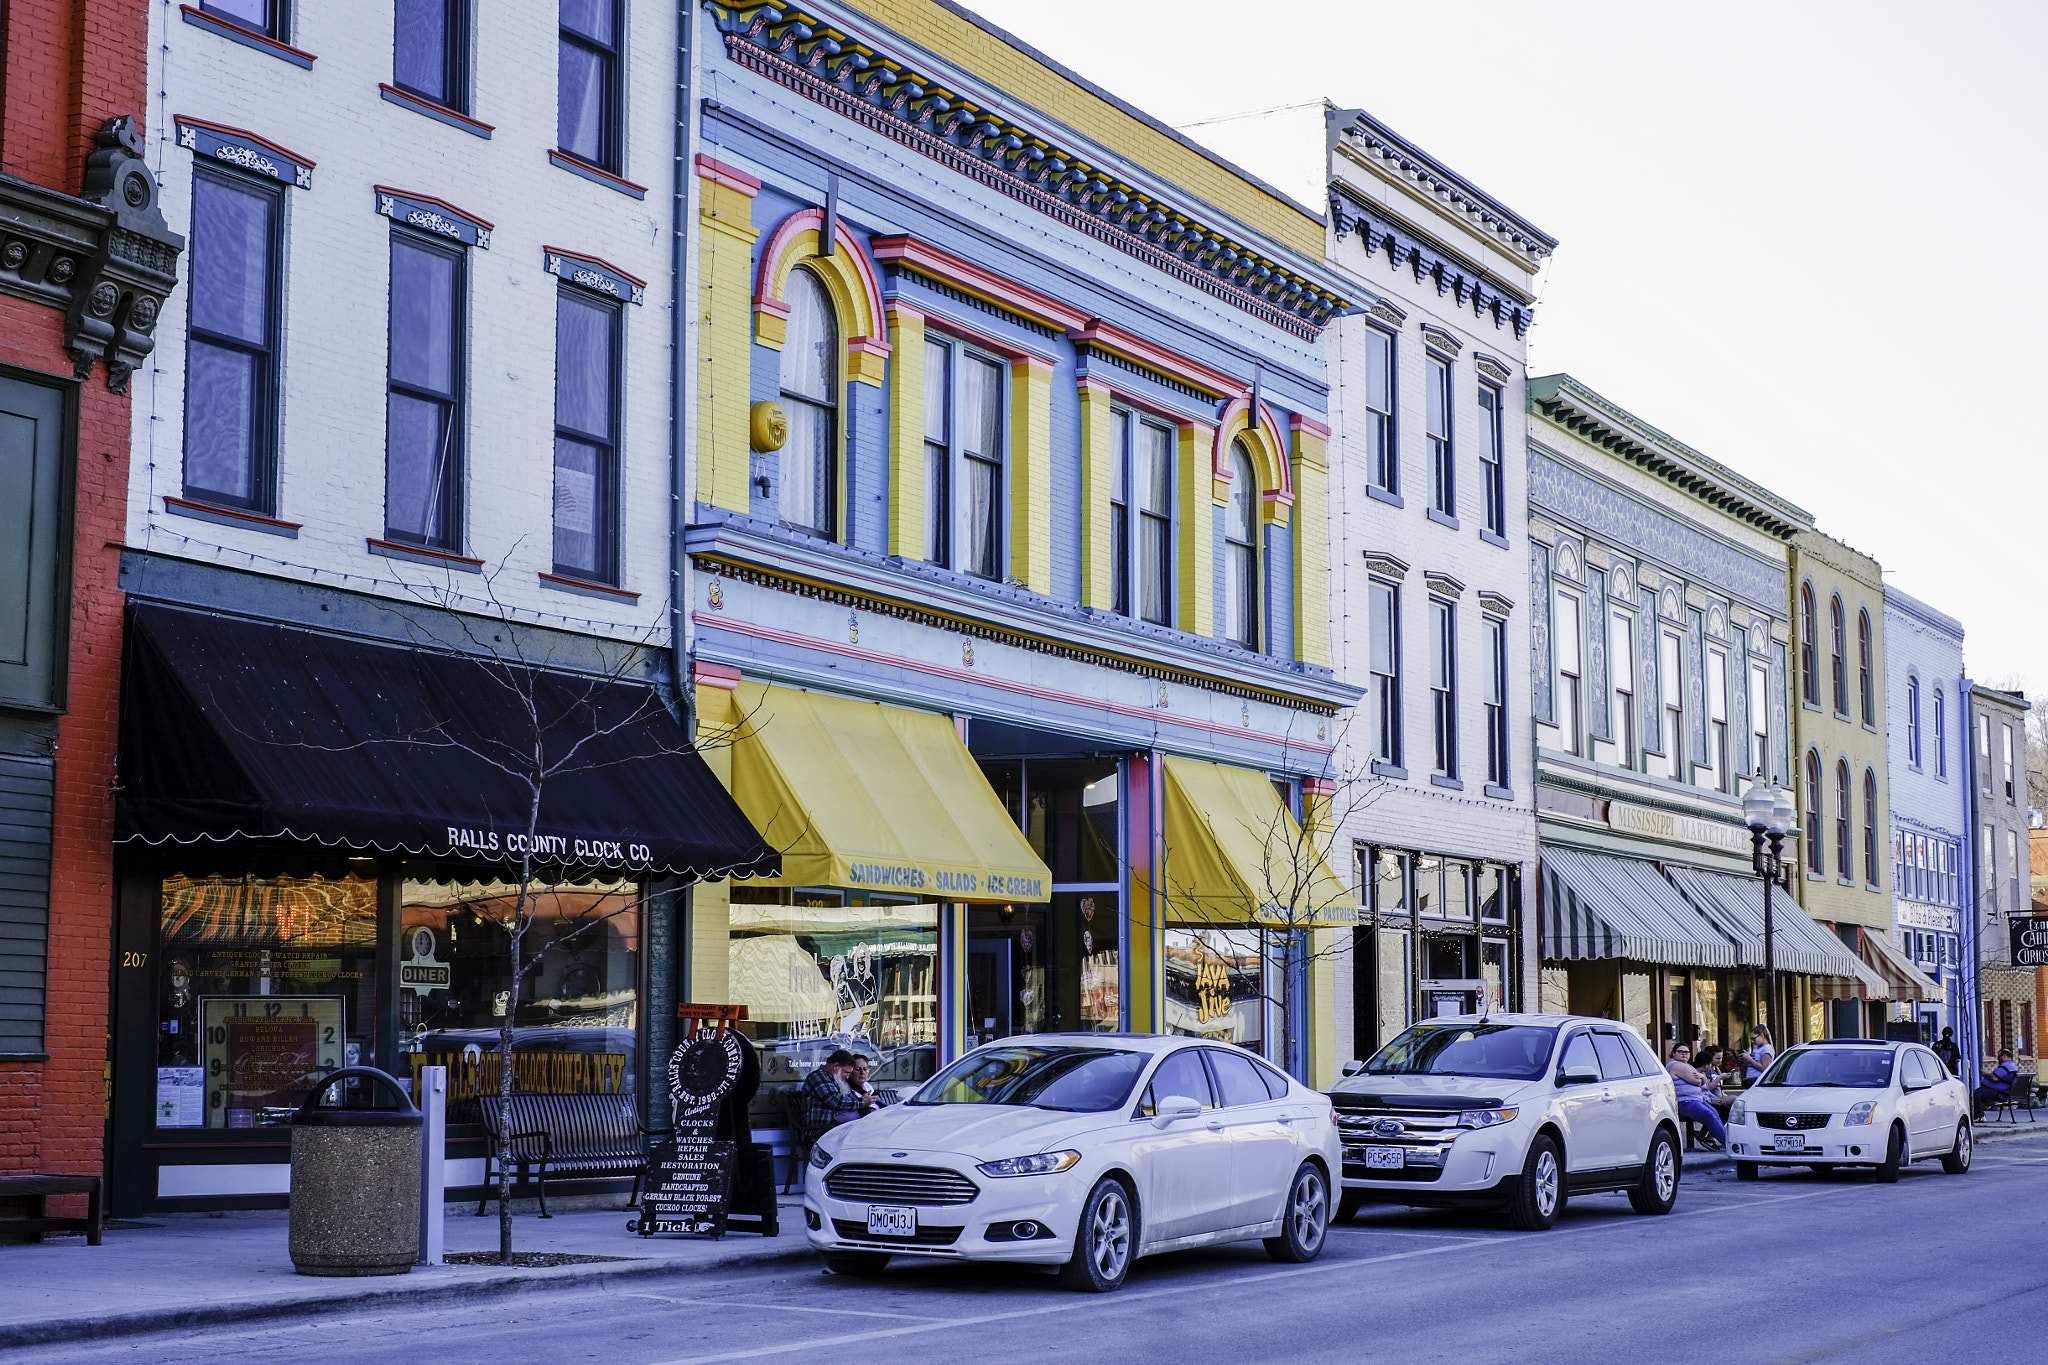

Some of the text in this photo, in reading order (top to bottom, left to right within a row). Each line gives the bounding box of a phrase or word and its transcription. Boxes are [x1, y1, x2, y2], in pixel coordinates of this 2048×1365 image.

[1618, 806, 1747, 850] MISSISSIPPI MARKETPLACE
[447, 827, 654, 862] RALLS COUNTY CLOCK CO.
[850, 862, 1042, 897] SANDWICHES SALADS ICE CREAM
[1324, 906, 1358, 922] PASTRIES
[2020, 930, 2048, 948] CABI
[123, 952, 148, 968] 207
[403, 968, 446, 982] DINER
[1195, 963, 1231, 992] JAVA
[265, 1002, 282, 1017] 12
[1198, 988, 1232, 1024] Jive
[208, 1025, 226, 1045] 10
[323, 1026, 335, 1045] 2
[210, 1058, 222, 1077] 9
[668, 1063, 682, 1093] RALLS
[723, 1038, 740, 1081] COMPANY
[410, 1051, 626, 1110] RLLS COUY CLOCK COMPANY
[210, 1090, 222, 1109] 8
[698, 1091, 717, 1106] 1982
[684, 1103, 711, 1117] Antique
[680, 1119, 714, 1127] CLOCKS
[692, 1128, 699, 1136] &
[676, 1145, 708, 1153] REPAIR
[1775, 1139, 1788, 1148] SK7
[678, 1153, 705, 1161] SALES
[1367, 1151, 1402, 1164] PC5 S5P
[660, 1161, 720, 1170] RESTORATION
[672, 1173, 702, 1181] GENUINE
[661, 1182, 709, 1192] HANDCRAFTED
[644, 1192, 722, 1203] GERMAN BLACK FOREST
[655, 1203, 681, 1212] CUCKOO
[643, 1221, 692, 1232] 1 Tick
[893, 1213, 913, 1229] U3J
